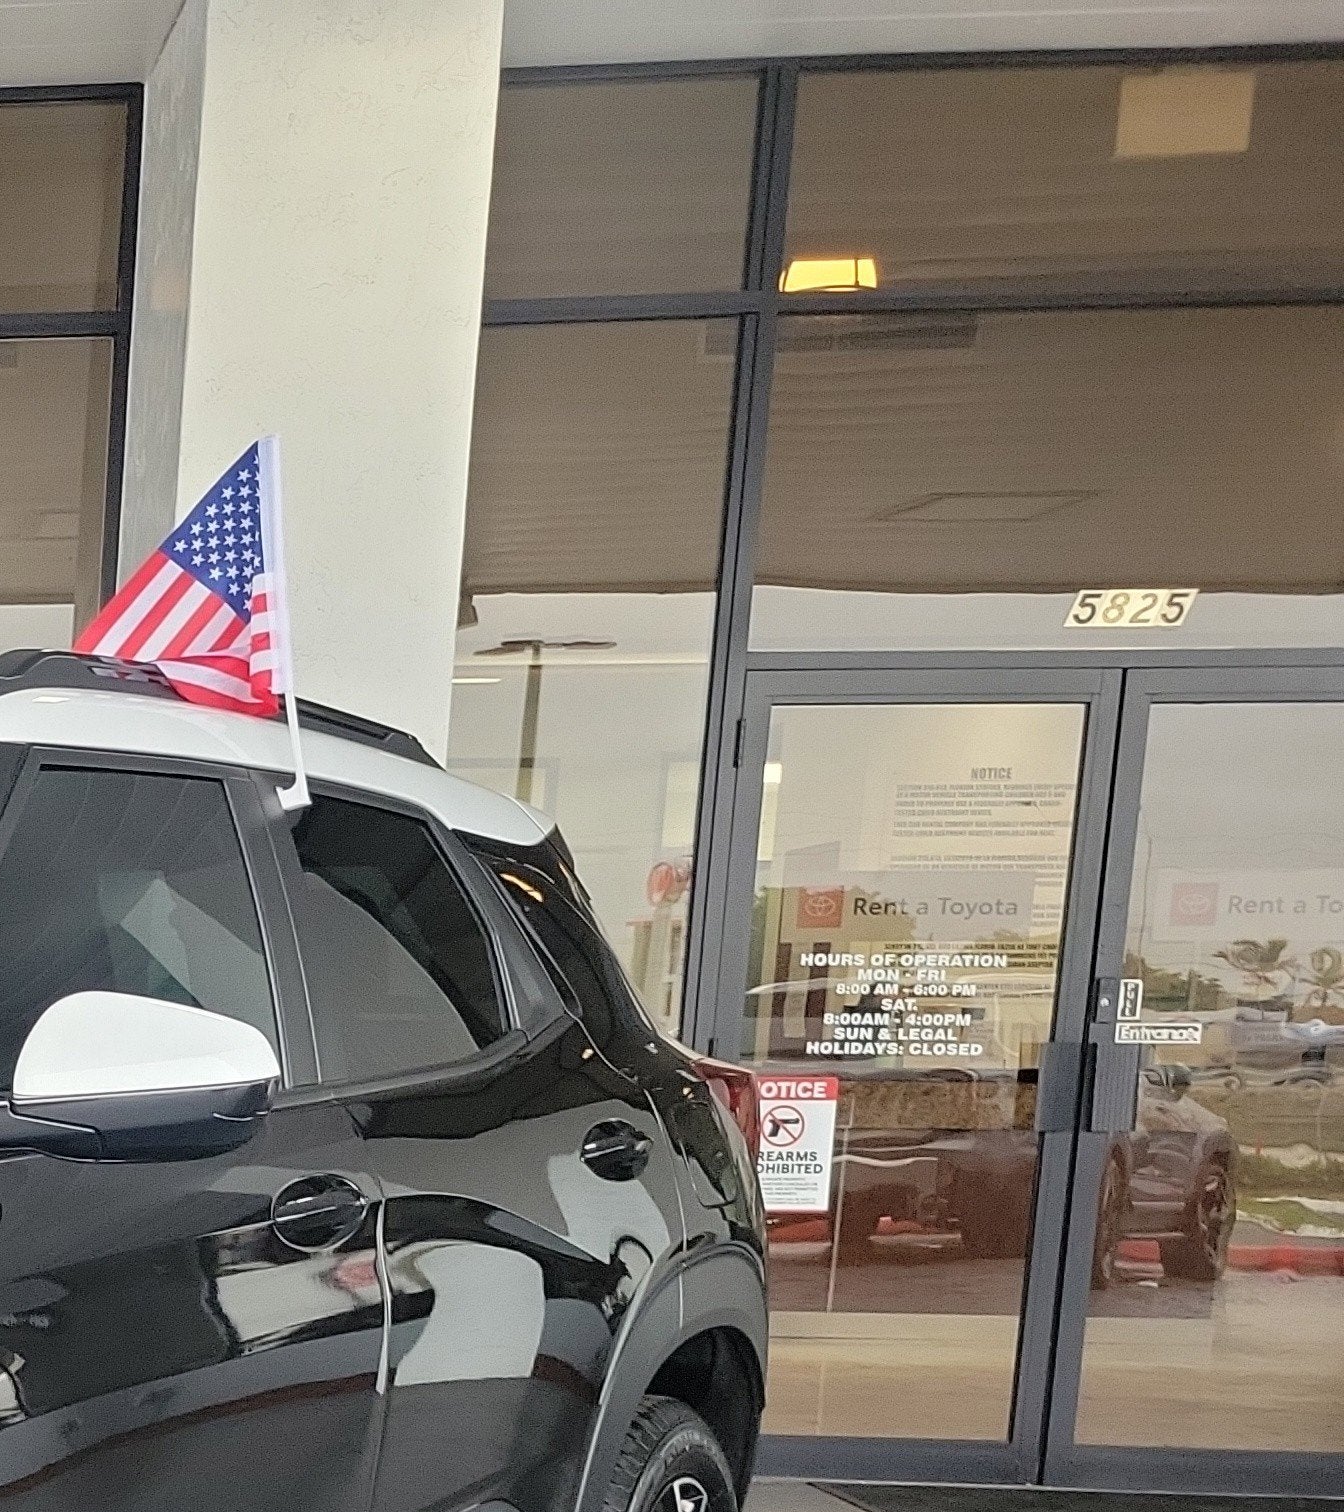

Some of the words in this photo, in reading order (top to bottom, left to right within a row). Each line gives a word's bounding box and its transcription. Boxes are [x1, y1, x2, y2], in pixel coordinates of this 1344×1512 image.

[1072, 592, 1191, 624] 5825
[970, 767, 1012, 780] NOTICE
[853, 897, 909, 916] Rent
[915, 901, 929, 915] a
[938, 897, 1018, 920] Toyota
[1228, 895, 1285, 914] Rent
[1293, 900, 1306, 914] a
[800, 953, 865, 966] HOURS
[870, 953, 896, 966] OF
[900, 954, 1007, 967] OPERATION
[857, 968, 900, 981] MON
[917, 969, 946, 981] FRI
[835, 983, 870, 995] 8:00
[873, 983, 899, 995] AM
[913, 984, 948, 995] 6:00
[951, 984, 977, 996] PM
[880, 998, 918, 1011] SAT.
[823, 1012, 889, 1025] 8:00AM
[905, 1013, 971, 1026] 4:00PM
[833, 1027, 873, 1040] SUN
[877, 1027, 891, 1040] &
[897, 1028, 957, 1040] LEGAL
[806, 1041, 904, 1055] HOLIDAYS:
[908, 1042, 983, 1055] CLOSED
[758, 1081, 827, 1098] OTICE
[758, 1151, 818, 1162] REARMS
[756, 1163, 823, 1174] OHIBITED
